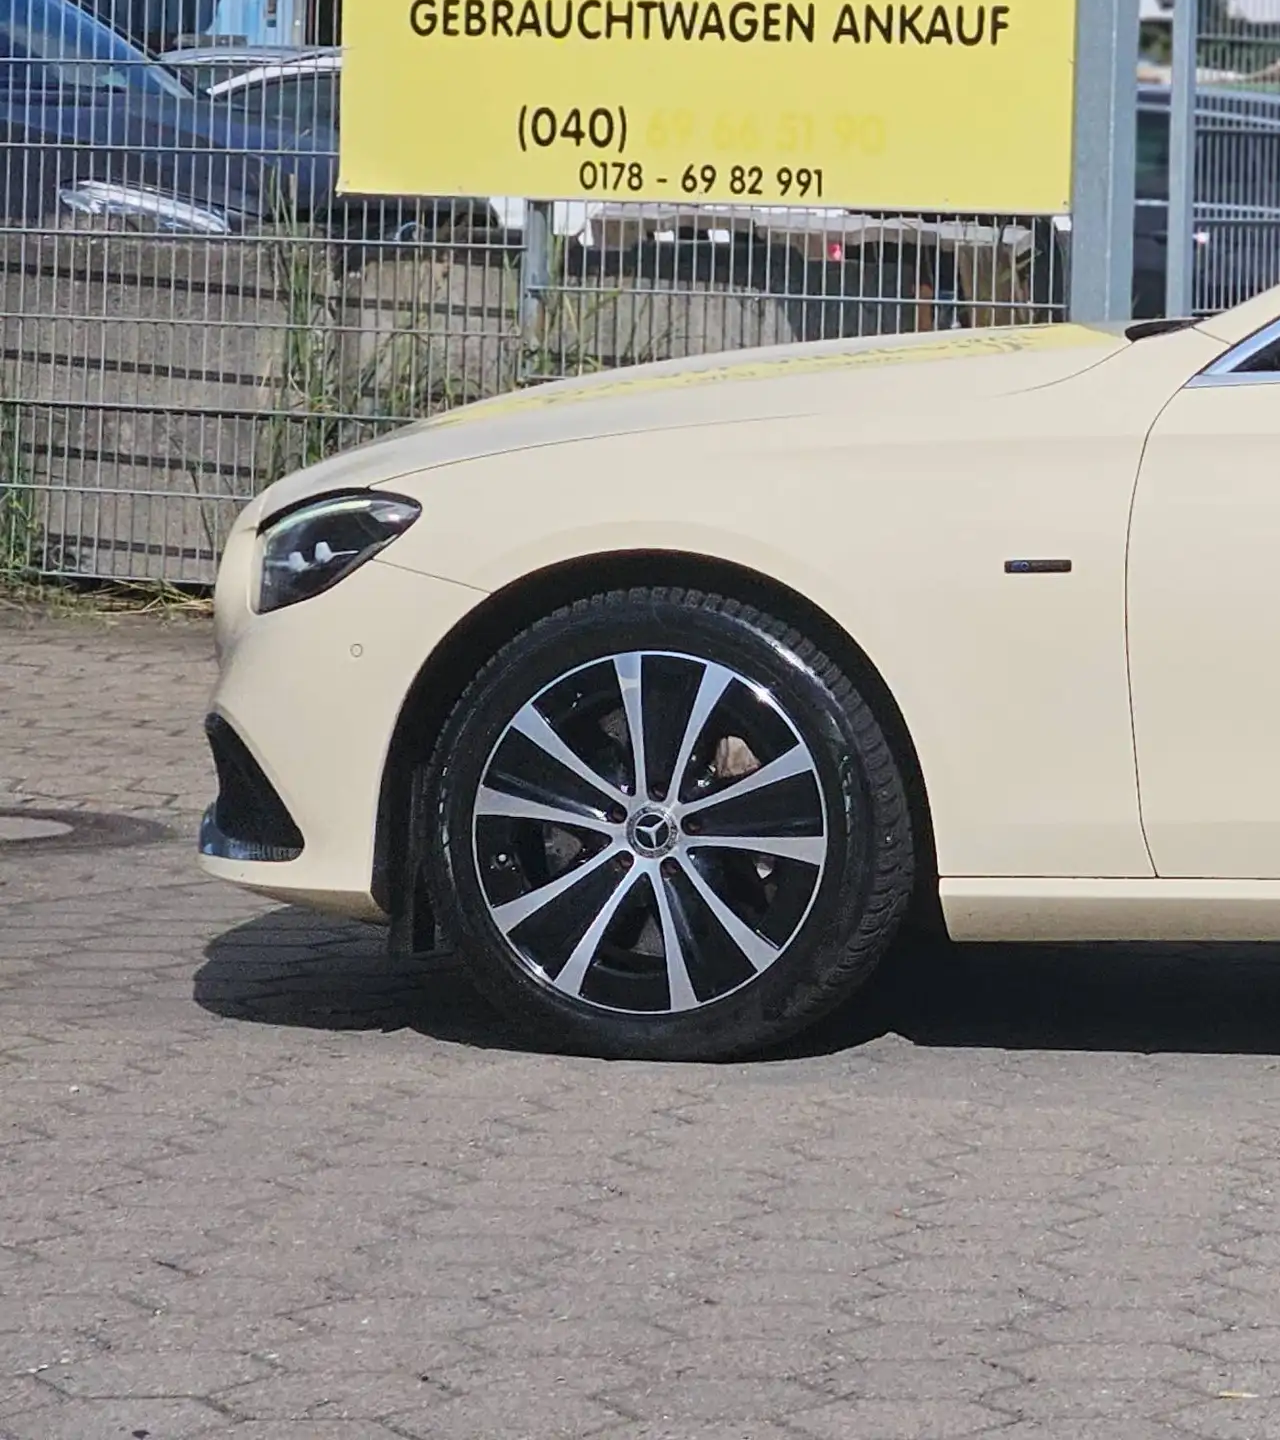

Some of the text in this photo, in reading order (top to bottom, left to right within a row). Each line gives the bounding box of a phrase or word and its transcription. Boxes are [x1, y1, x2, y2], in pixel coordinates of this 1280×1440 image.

[833, 3, 1009, 45] ANKAUF
[517, 106, 627, 153] (040)
[579, 161, 642, 191] 0178
[682, 165, 716, 193] 69
[729, 166, 762, 195] 82
[777, 168, 823, 197] 991
